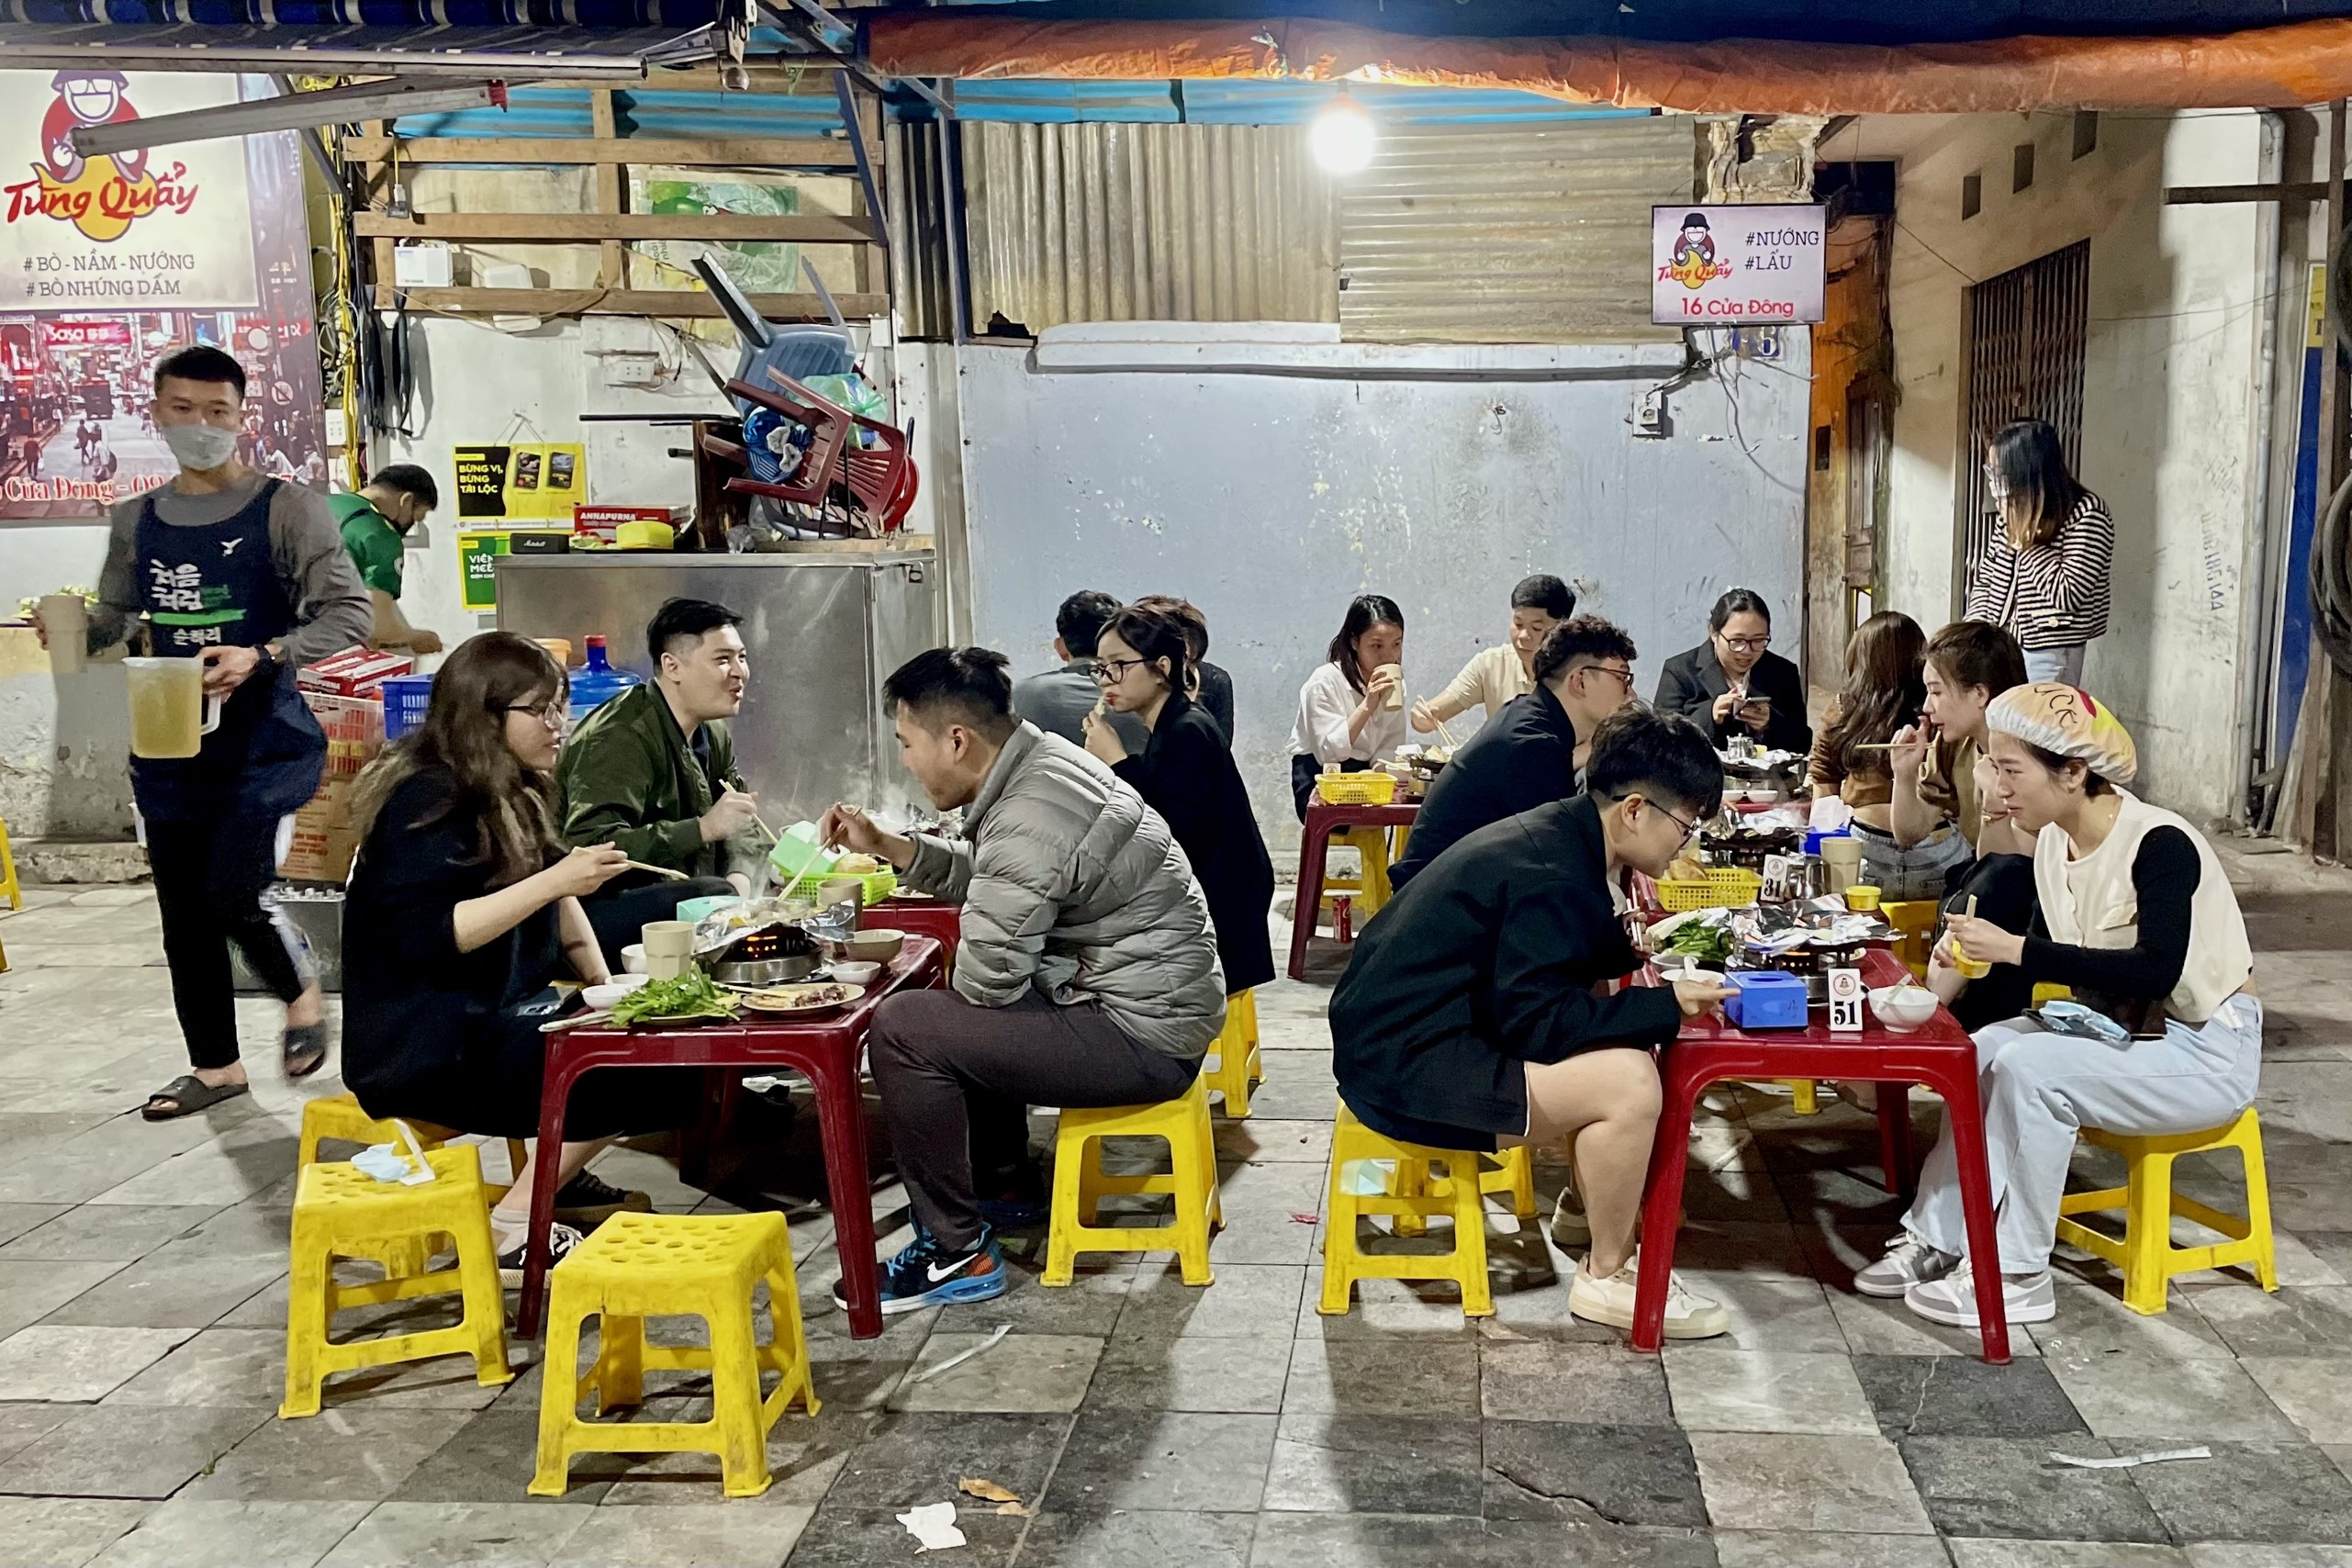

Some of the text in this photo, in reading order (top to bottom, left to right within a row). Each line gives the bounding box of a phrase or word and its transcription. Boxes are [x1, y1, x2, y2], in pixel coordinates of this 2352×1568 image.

[67, 276, 134, 296] NHÚNG
[1682, 297, 1794, 318] 16 Cửa Đông
[580, 511, 636, 521] ANNAPURNA
[1764, 878, 1781, 897] 31
[1833, 999, 1858, 1025] 51
